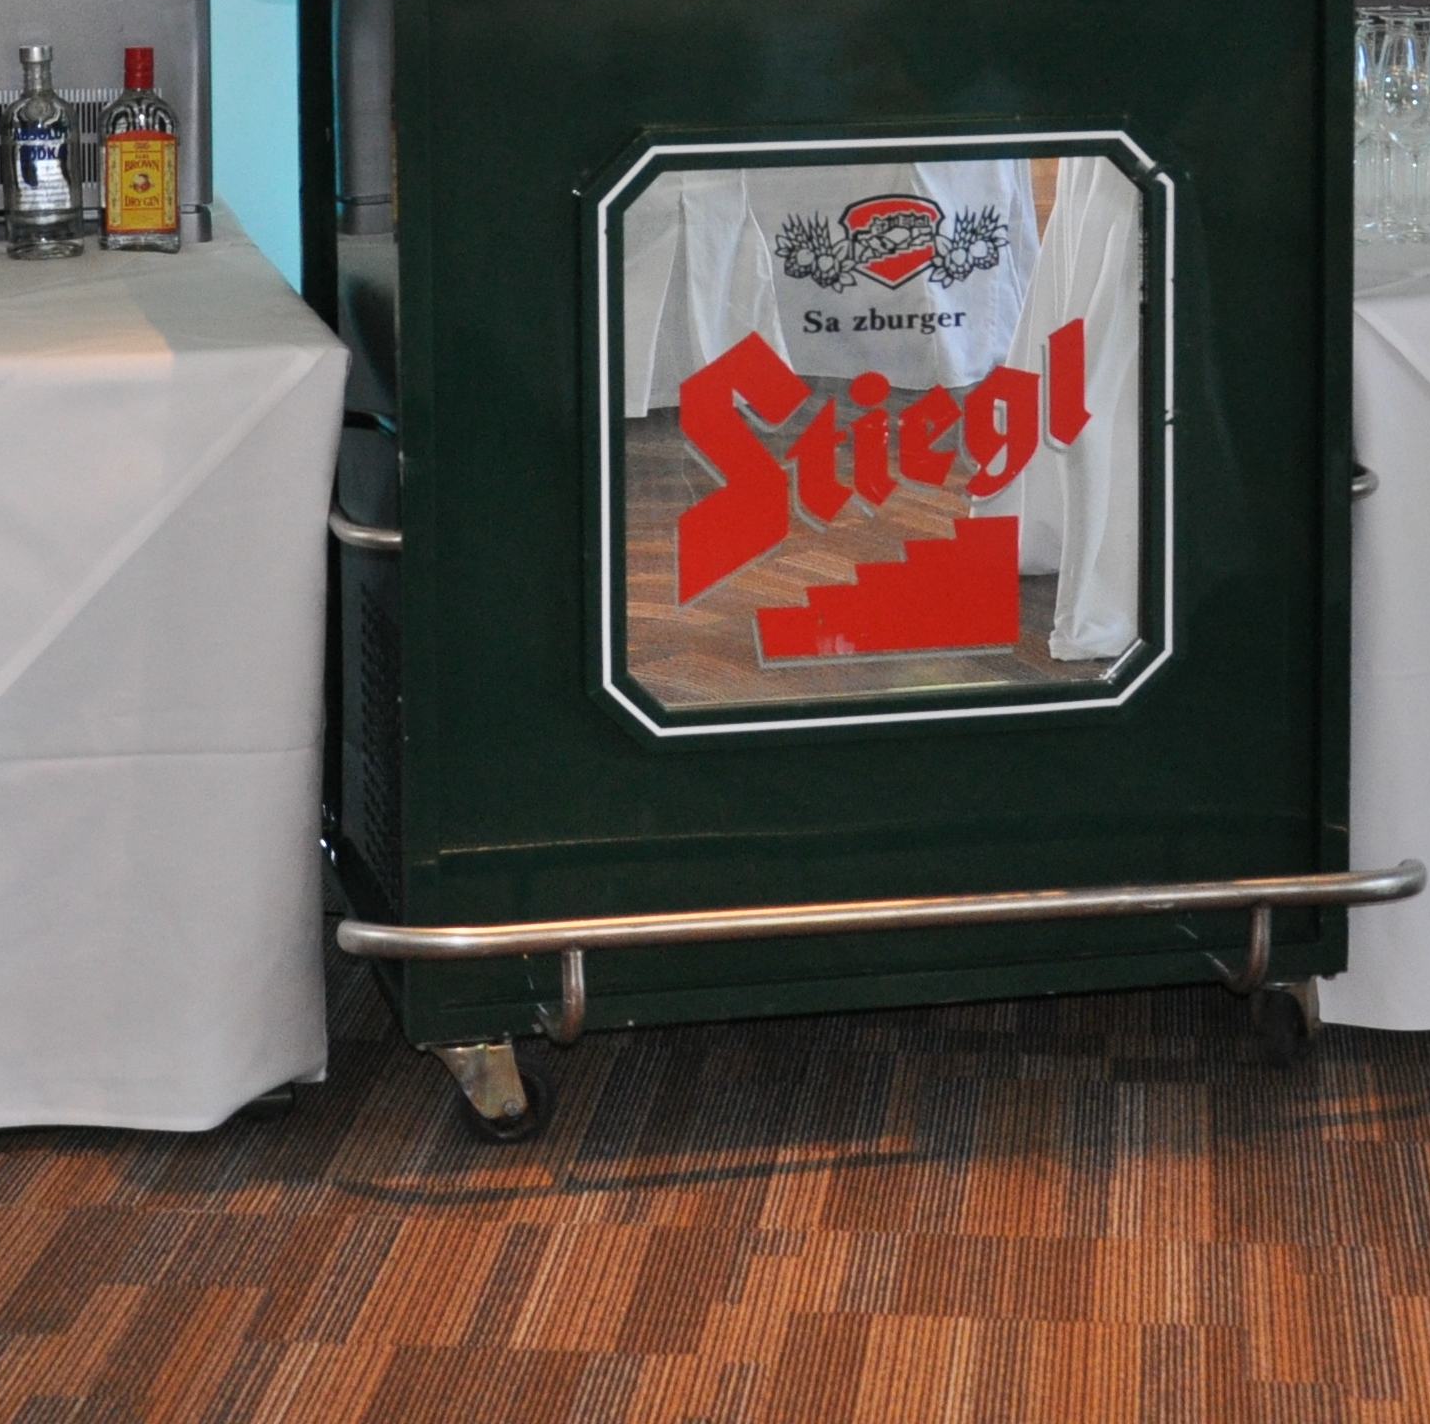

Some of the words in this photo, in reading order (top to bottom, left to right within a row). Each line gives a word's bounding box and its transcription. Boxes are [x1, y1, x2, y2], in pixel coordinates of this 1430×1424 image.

[124, 195, 142, 206] DRY
[143, 195, 160, 206] GIN
[678, 318, 1093, 606] Stiegl
